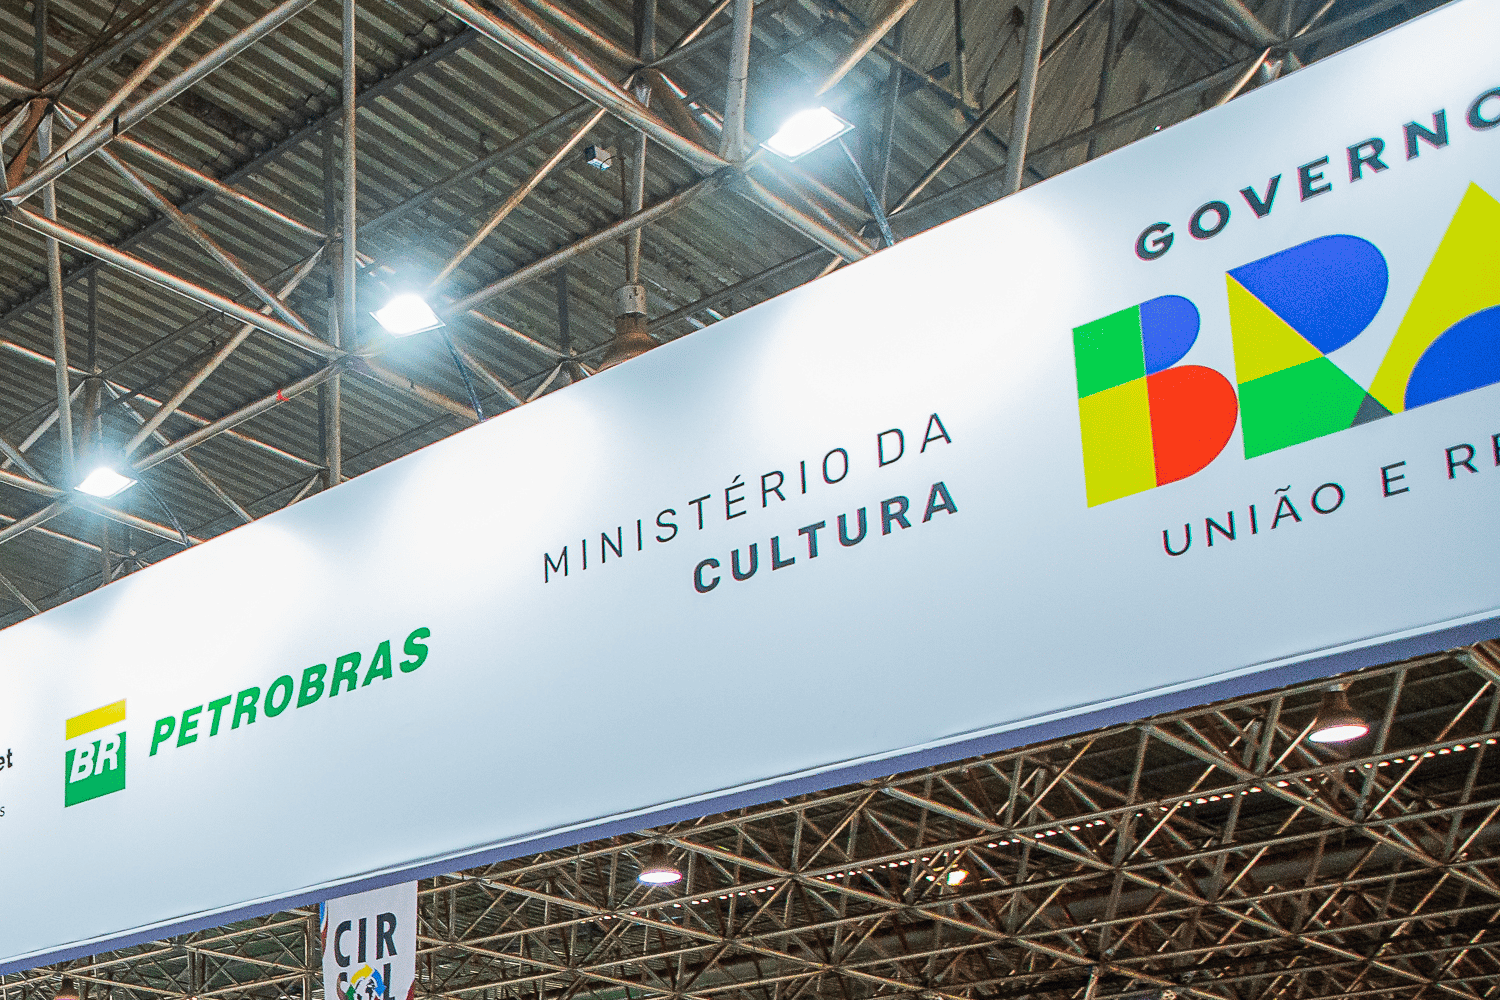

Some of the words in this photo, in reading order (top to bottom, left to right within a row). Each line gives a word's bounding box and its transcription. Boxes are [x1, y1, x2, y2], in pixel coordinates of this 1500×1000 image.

[543, 447, 849, 583] MINISTÉRIO
[877, 413, 952, 468] DA
[693, 481, 958, 594] CULTURA
[1162, 482, 1346, 556] UNIÃO
[1380, 461, 1411, 497] E
[149, 627, 431, 757] PETROBRAS
[69, 734, 121, 784] BR
[334, 912, 397, 968] CIR
